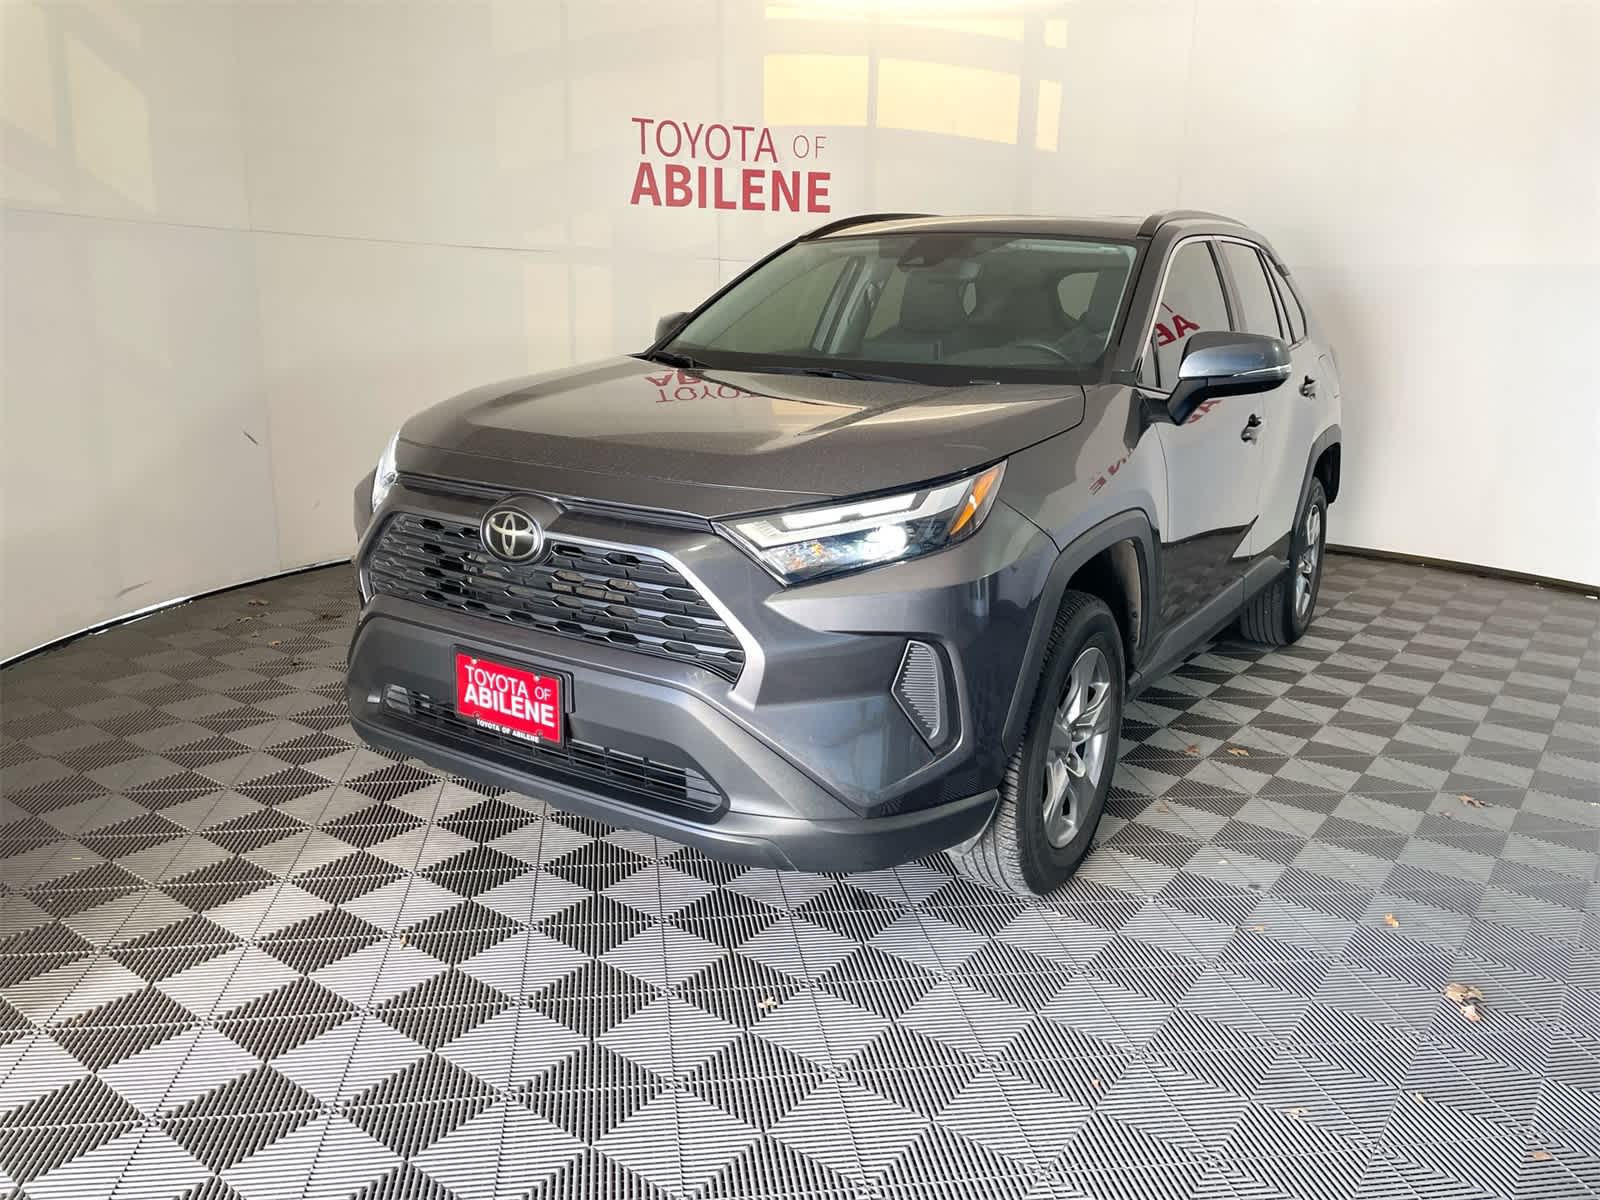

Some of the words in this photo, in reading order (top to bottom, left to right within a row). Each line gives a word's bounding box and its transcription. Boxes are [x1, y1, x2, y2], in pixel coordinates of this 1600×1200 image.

[631, 117, 778, 163] TOYOTA
[792, 134, 827, 160] OF
[630, 162, 831, 213] ABILENE
[464, 665, 529, 699] TOYOTA
[534, 687, 552, 701] OF
[464, 683, 555, 728] ABILENE
[476, 719, 500, 732] TOYOTA
[501, 726, 511, 734] OF
[511, 730, 540, 743] ABILENE
